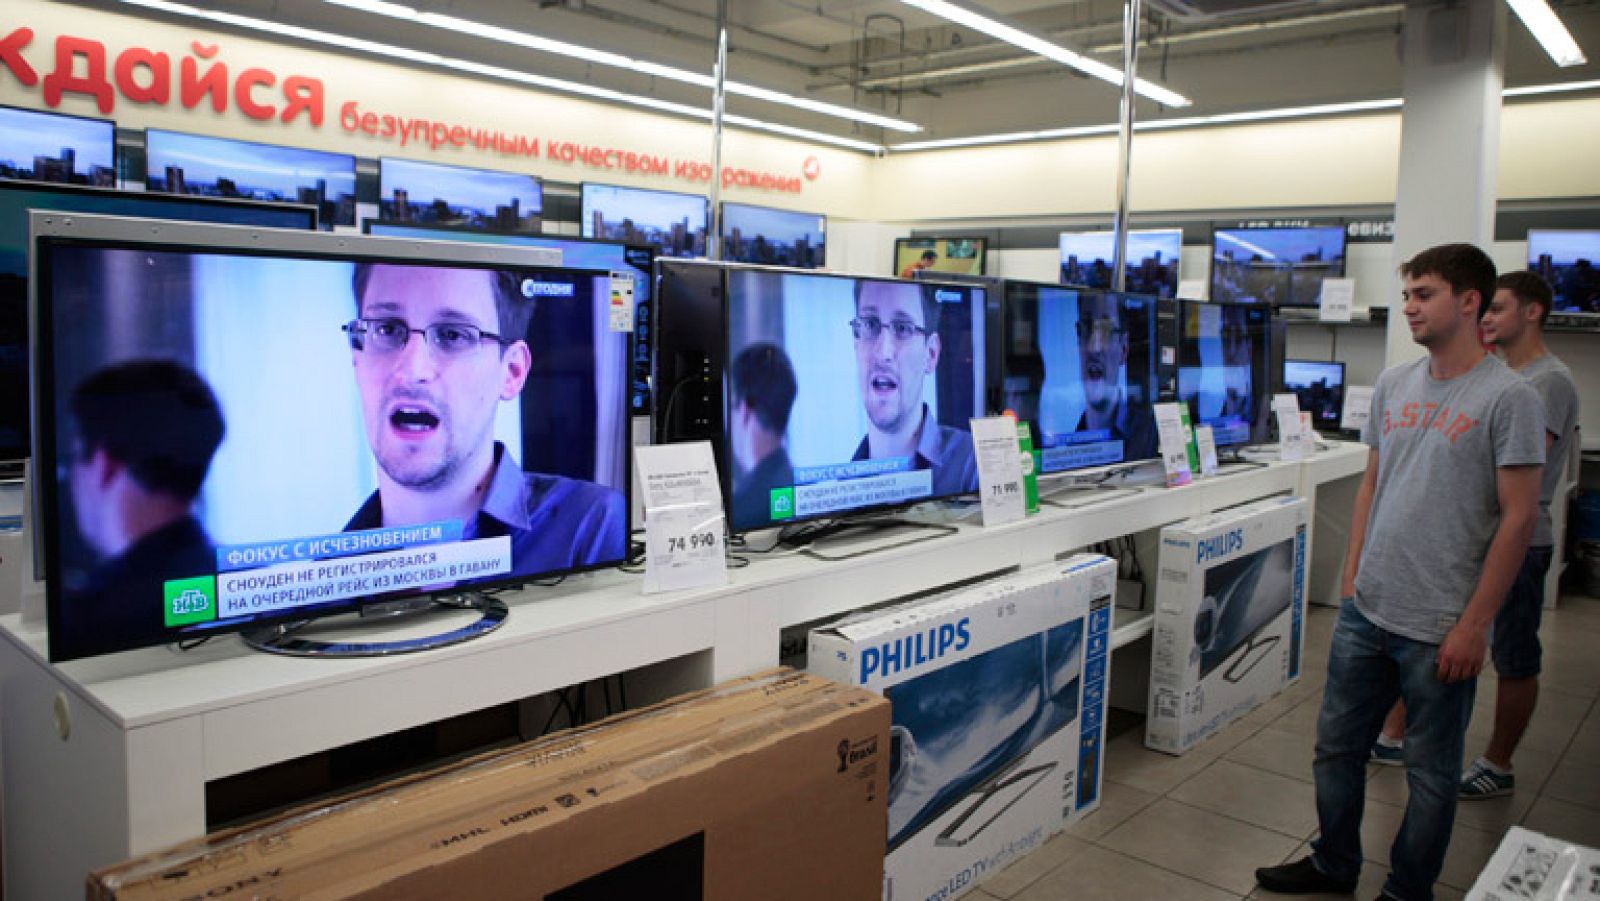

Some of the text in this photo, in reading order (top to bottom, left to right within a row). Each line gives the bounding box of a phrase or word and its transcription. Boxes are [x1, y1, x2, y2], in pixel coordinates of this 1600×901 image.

[339, 101, 802, 195] безупречным качеством изоражения
[227, 526, 443, 565] ФОКУС С ИСЧЕЗНОВЕНИЕМ
[668, 536, 686, 553] 74
[1197, 527, 1243, 565] PHILIPS
[226, 552, 437, 593] СНОУДЕН НЕ РЕГИСТРИРОВАЛСЯ
[228, 558, 500, 611] НА ОЧЕРЕДНОЙ РЕЙС ИЗ МОСКВЫ В ГАВАНУ
[859, 617, 970, 685] PHILIPS
[949, 868, 972, 893] LED
